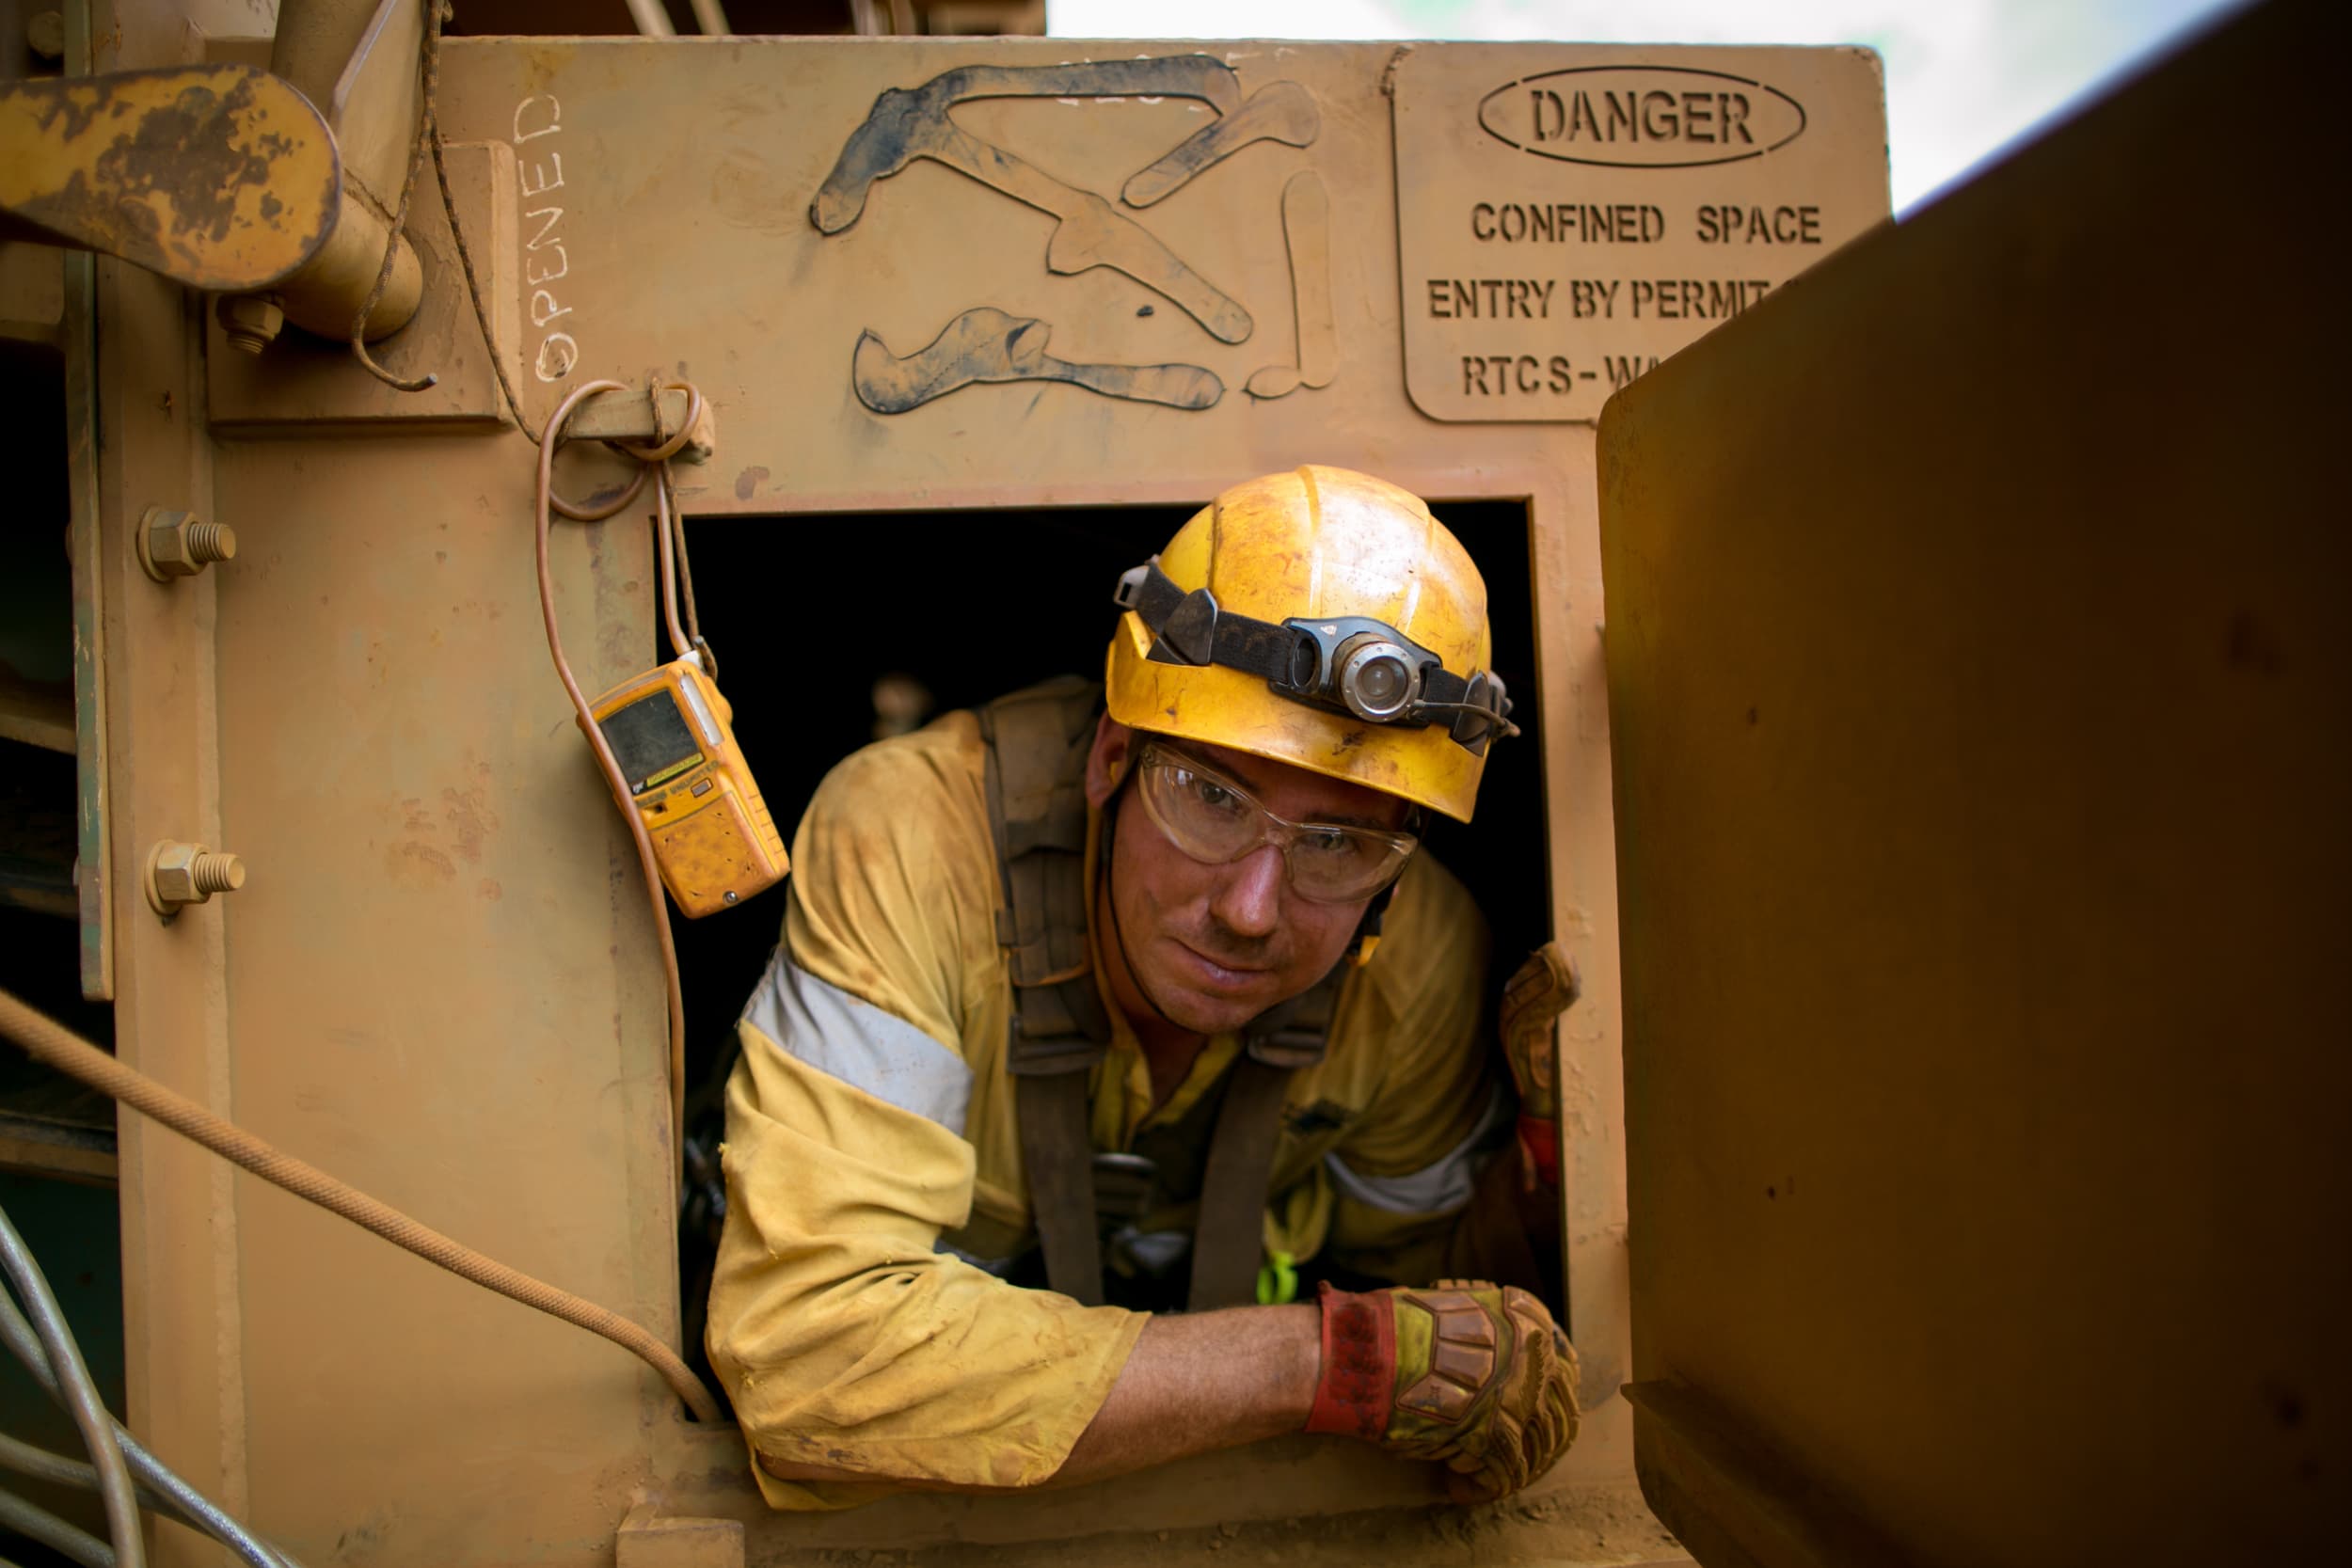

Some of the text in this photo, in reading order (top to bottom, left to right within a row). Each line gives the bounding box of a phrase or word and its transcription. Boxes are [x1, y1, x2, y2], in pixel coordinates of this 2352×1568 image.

[1531, 90, 1754, 143] DANGER
[514, 94, 578, 382] OPENED
[1471, 202, 1821, 244] CONFINED SPACE
[1427, 279, 1771, 319] ENTRY BY PERMIT
